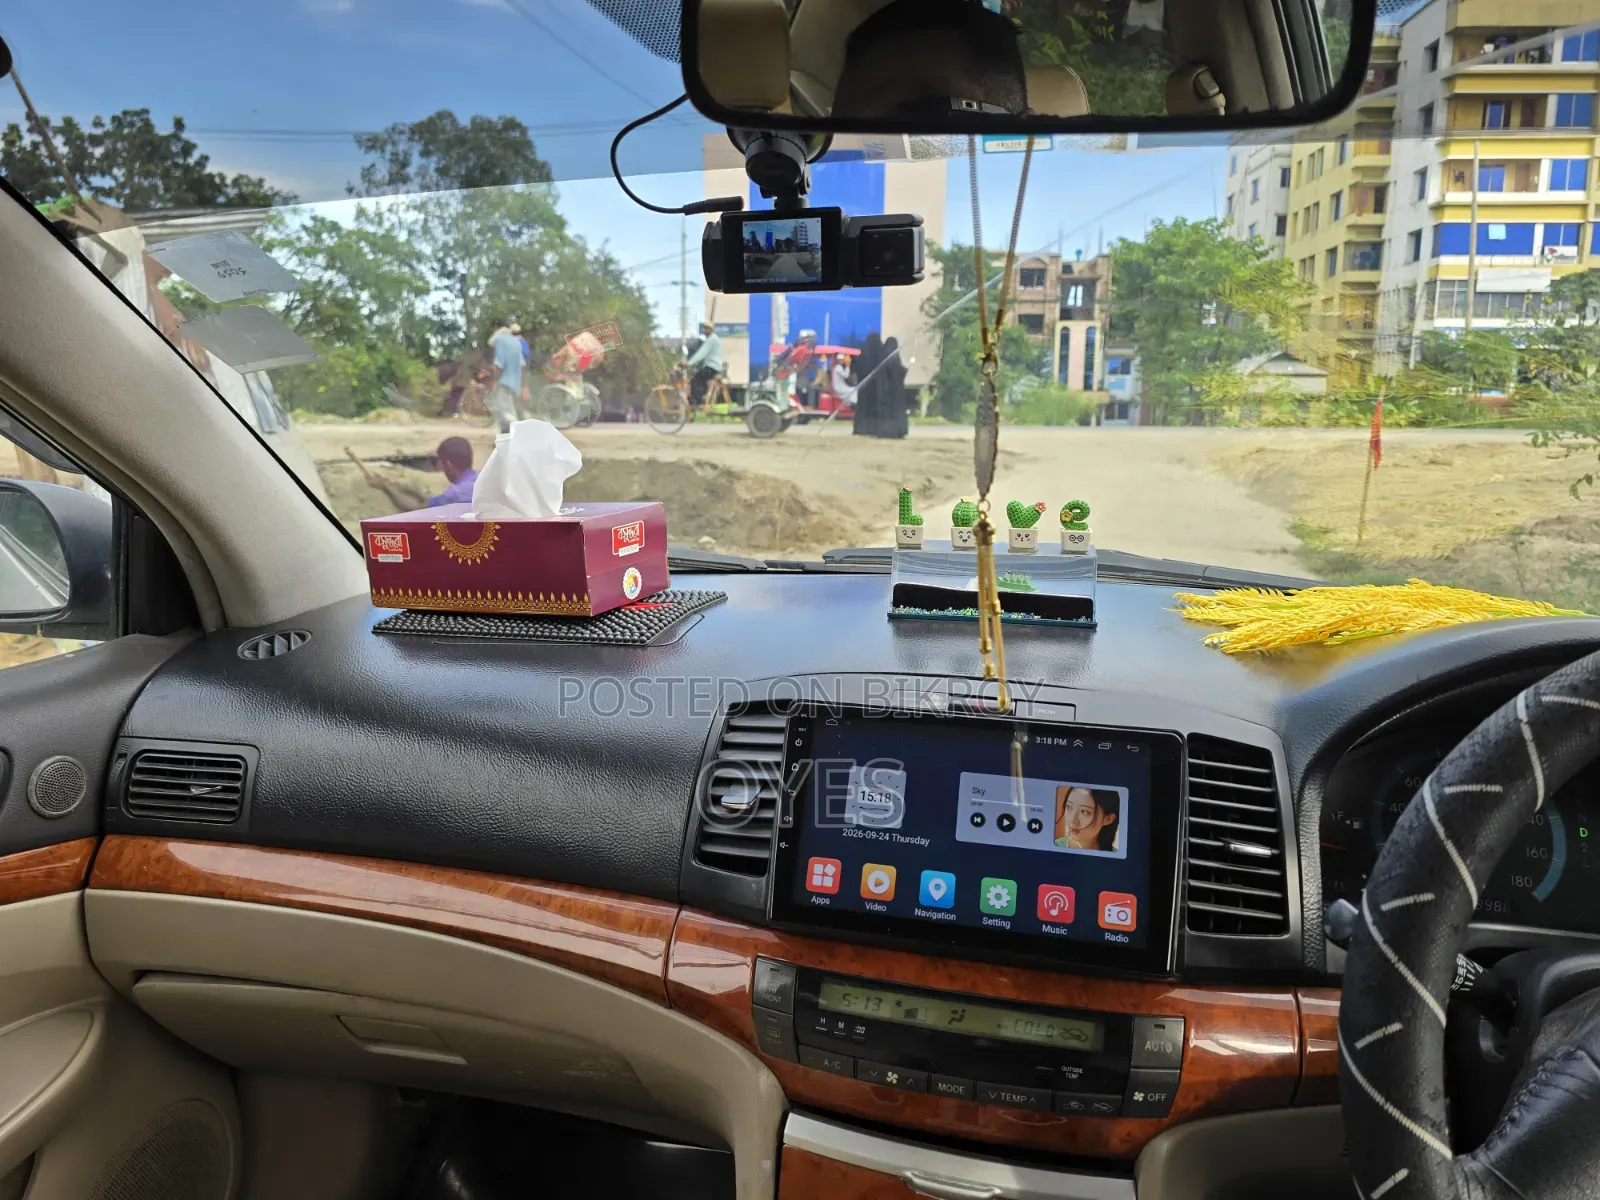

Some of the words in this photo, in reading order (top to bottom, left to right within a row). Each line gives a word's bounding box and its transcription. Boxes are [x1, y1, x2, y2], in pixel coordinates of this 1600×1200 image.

[1035, 736, 1052, 745] 3:18
[1053, 738, 1067, 746] PM
[1405, 777, 1422, 788] 60
[860, 789, 892, 804] 15:18
[971, 786, 986, 796] Sky
[842, 827, 891, 843] 2026-09-24
[891, 833, 931, 847] Thursday
[1579, 827, 1588, 838] D
[1526, 847, 1548, 859] 160
[1511, 875, 1533, 888] 180
[810, 895, 831, 906] Apps
[865, 902, 888, 912] Video
[914, 907, 957, 922] Navigation
[982, 916, 1011, 930] Setting
[1042, 924, 1068, 936] Music
[1104, 932, 1129, 944] Radio
[762, 994, 782, 1003] FRONT
[842, 993, 883, 1012] 5:13
[838, 1021, 844, 1029] M
[1144, 1040, 1173, 1054] AUTO
[823, 1059, 841, 1069] A/C
[1061, 1066, 1083, 1074] OUTSIDE
[938, 1082, 965, 1096] MODE
[1000, 1092, 1027, 1103] TEMP
[1147, 1092, 1167, 1104] OFF
